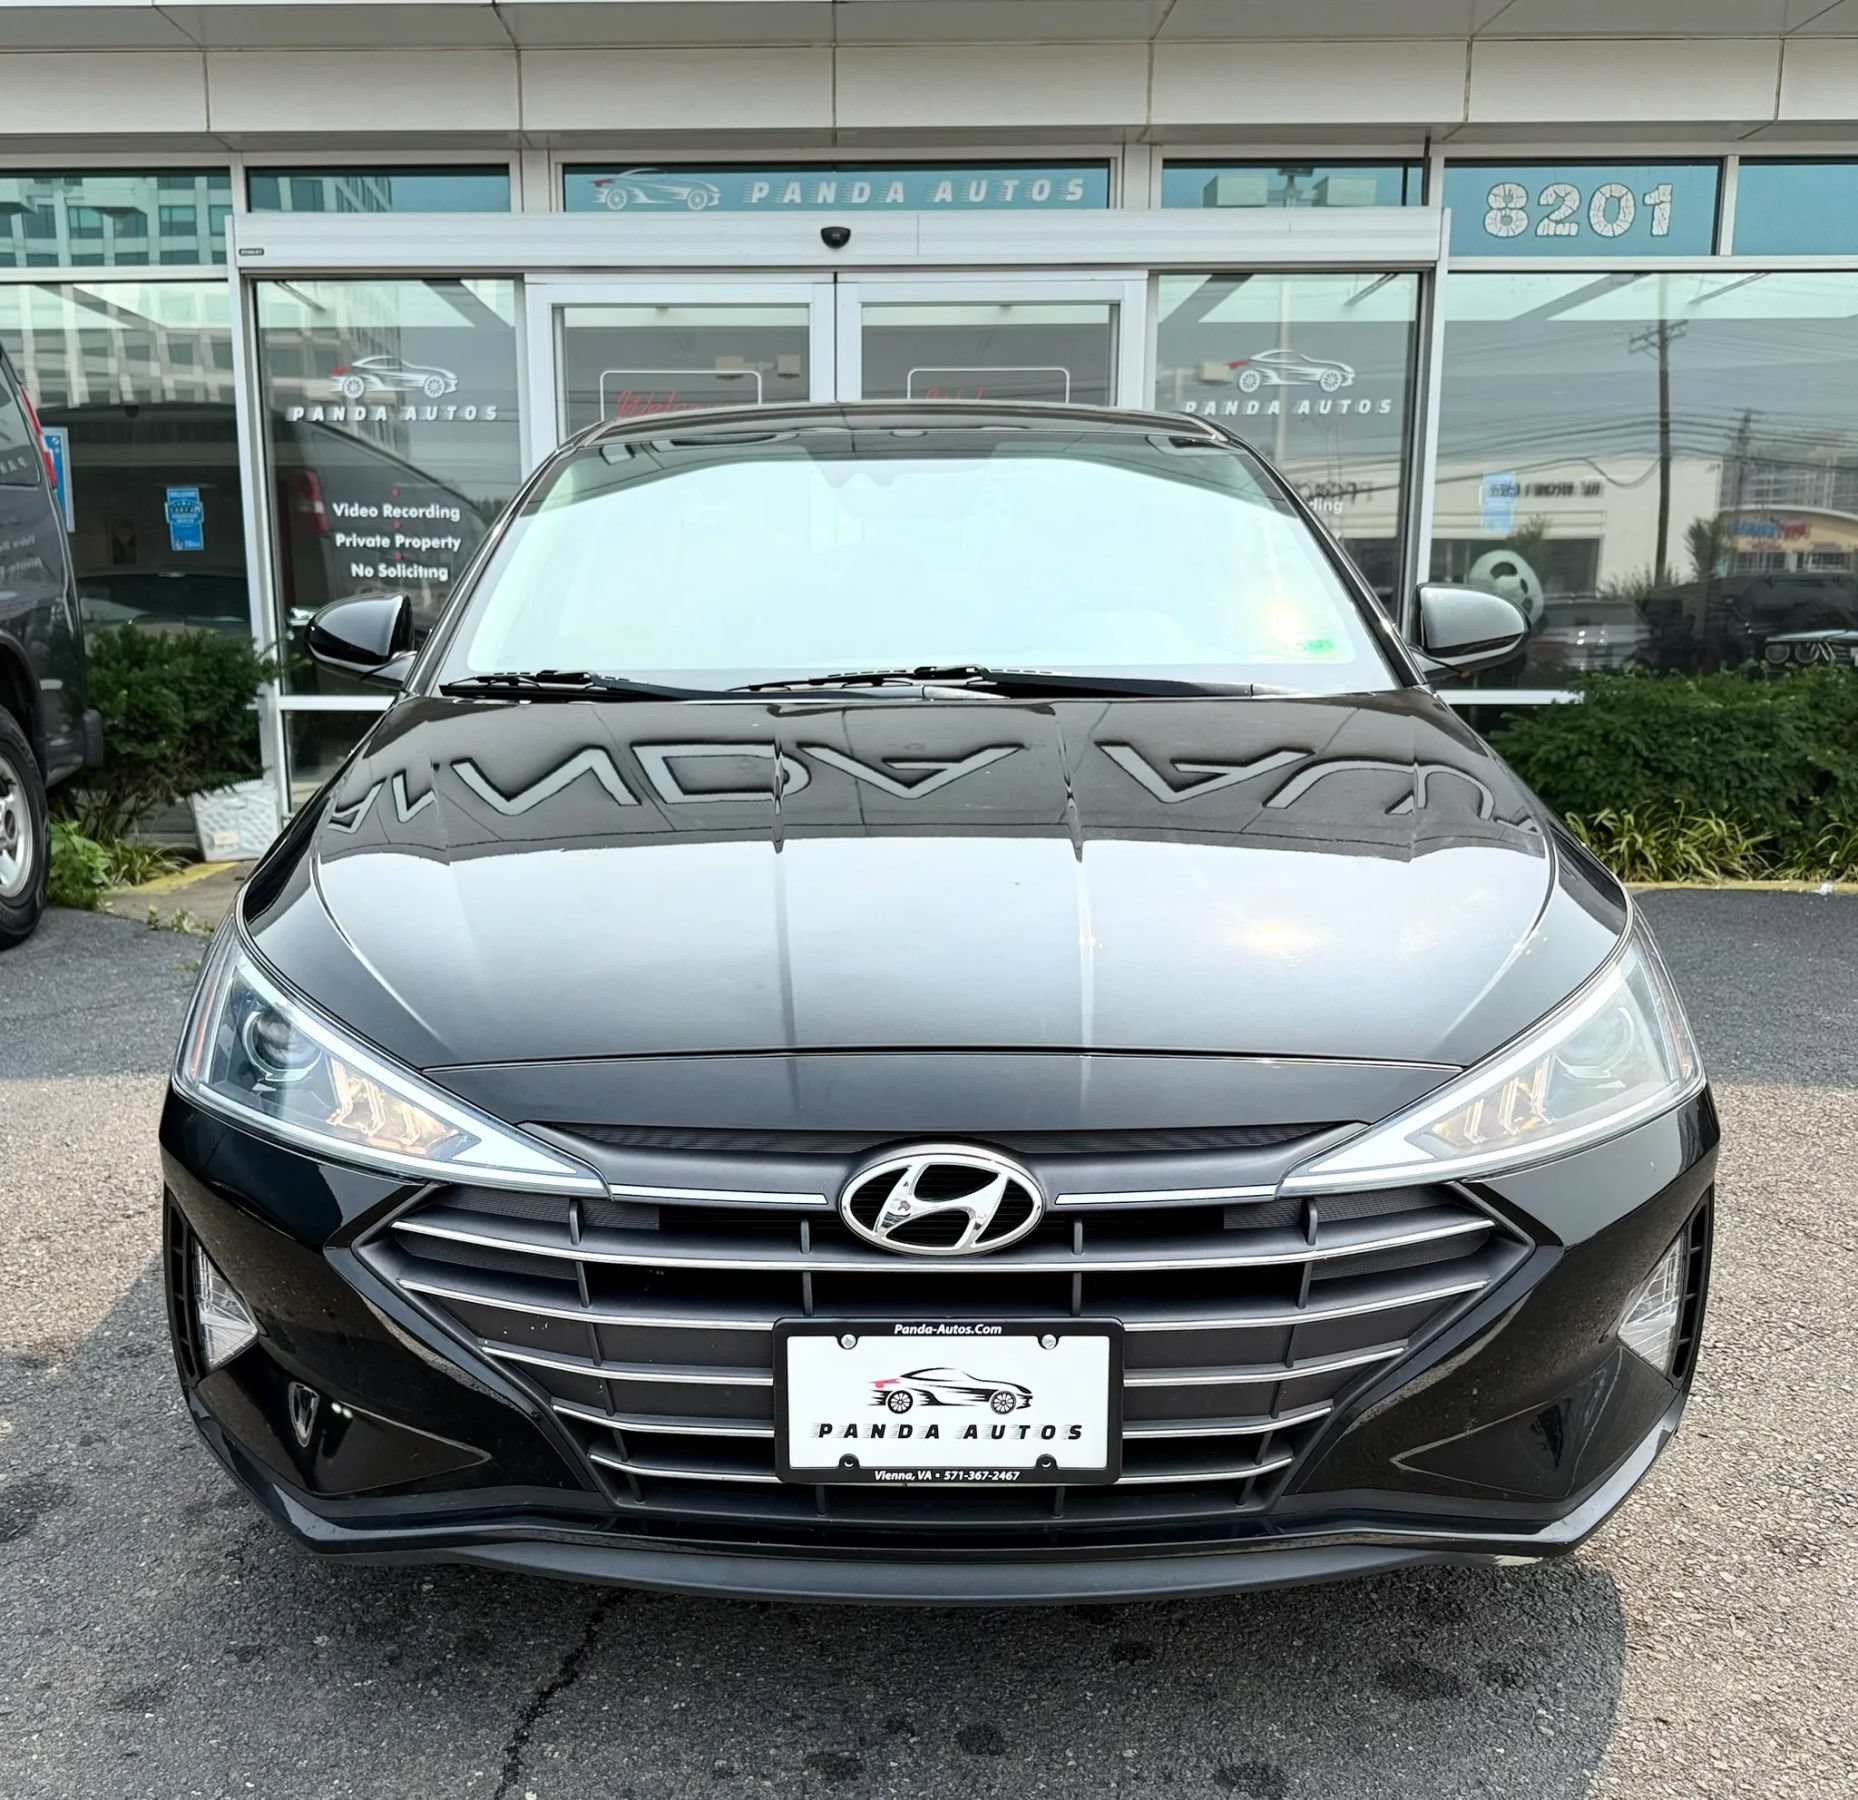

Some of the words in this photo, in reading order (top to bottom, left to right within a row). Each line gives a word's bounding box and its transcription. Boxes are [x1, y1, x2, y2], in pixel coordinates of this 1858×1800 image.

[748, 181, 904, 204] PANDA
[932, 178, 1085, 202] AUTOS
[1483, 182, 1673, 239] 8201
[290, 405, 388, 422] PANDA
[405, 405, 498, 421] AUTOS
[1184, 400, 1281, 416] PANDA
[1298, 399, 1393, 415] AUTOS
[332, 503, 379, 518] Video
[382, 503, 461, 521] Recording
[335, 533, 391, 548] Private
[394, 534, 462, 552] Property
[351, 563, 374, 578] No
[378, 563, 449, 581] Soliciting
[894, 1324, 1002, 1336] Panda-Autos.Com
[817, 1423, 940, 1440] PANDA
[963, 1424, 1083, 1440] AUTOS
[874, 1470, 916, 1482] Vienna,
[917, 1471, 933, 1481] VA
[943, 1471, 1020, 1481] 571-367-2467
